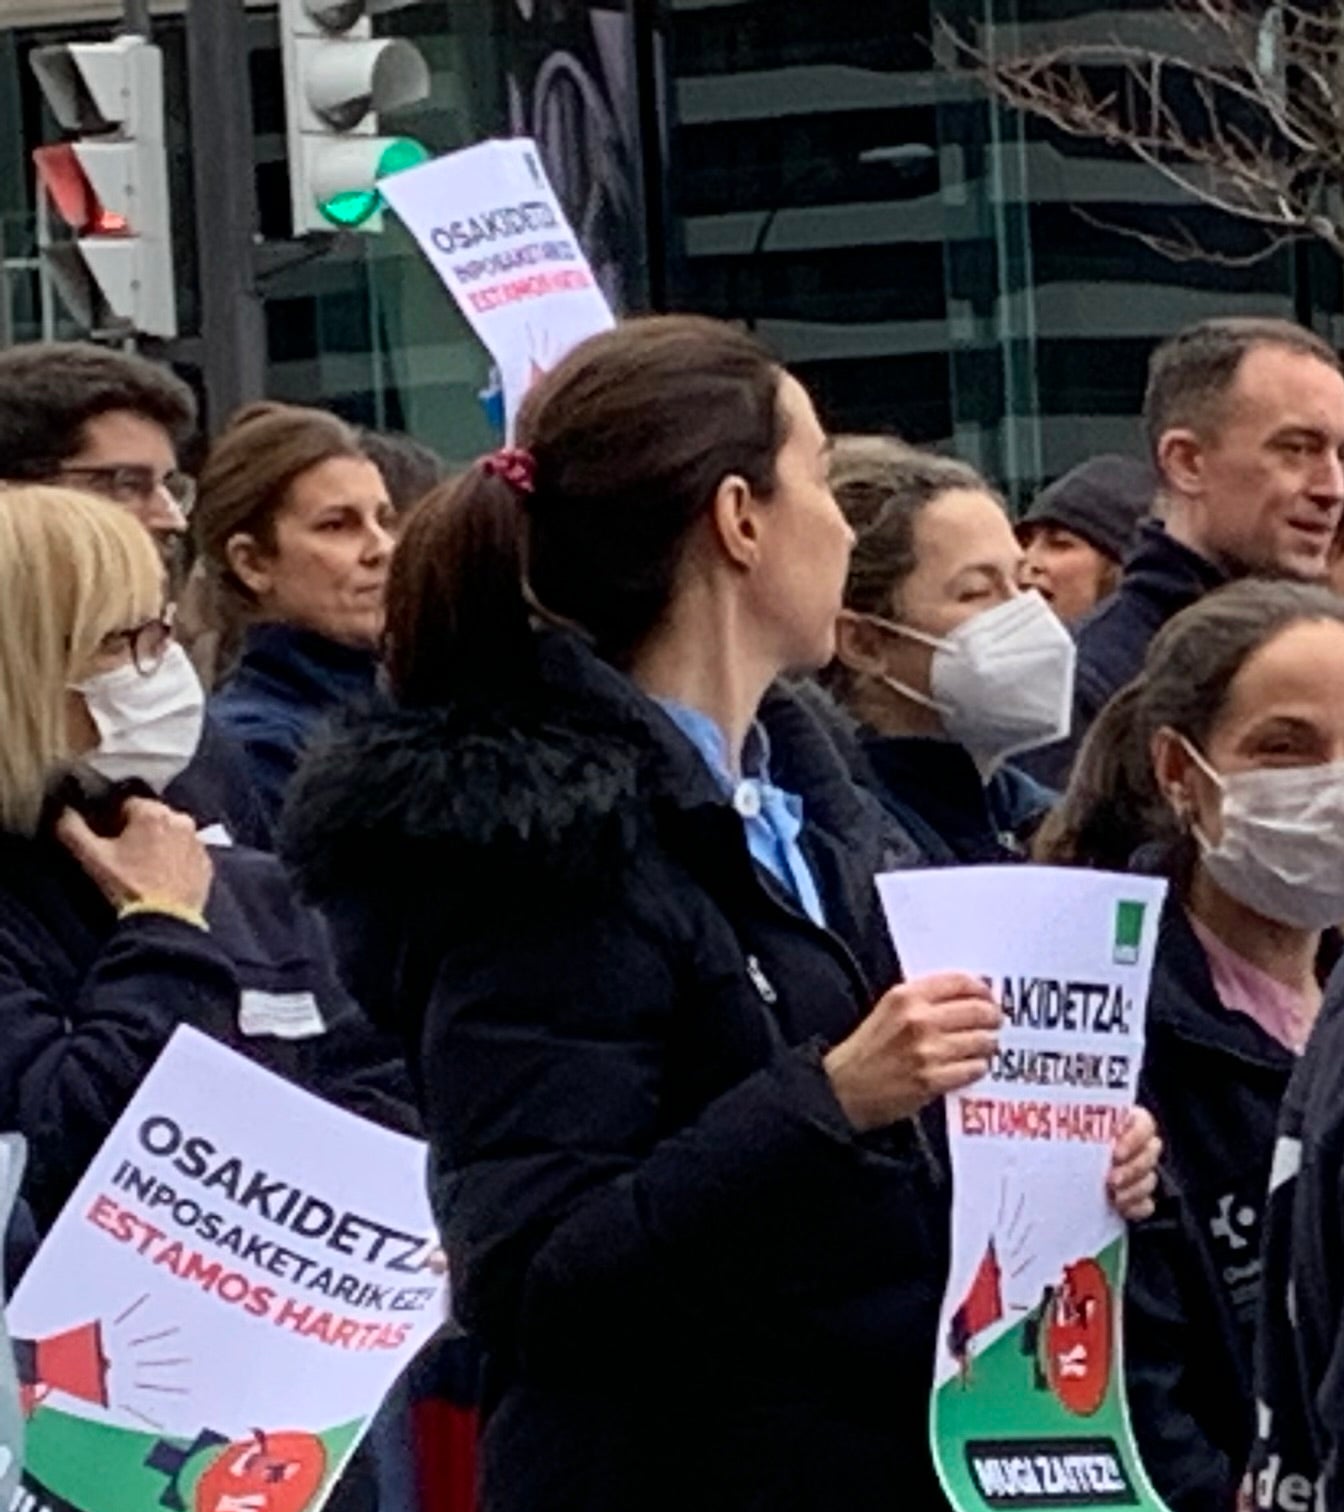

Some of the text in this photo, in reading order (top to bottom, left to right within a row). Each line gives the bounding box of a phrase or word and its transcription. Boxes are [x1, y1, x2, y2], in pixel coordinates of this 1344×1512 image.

[86, 1194, 414, 1352] ESTAMOS HARTAS
[111, 1160, 394, 1312] INPOSAKETARIK
